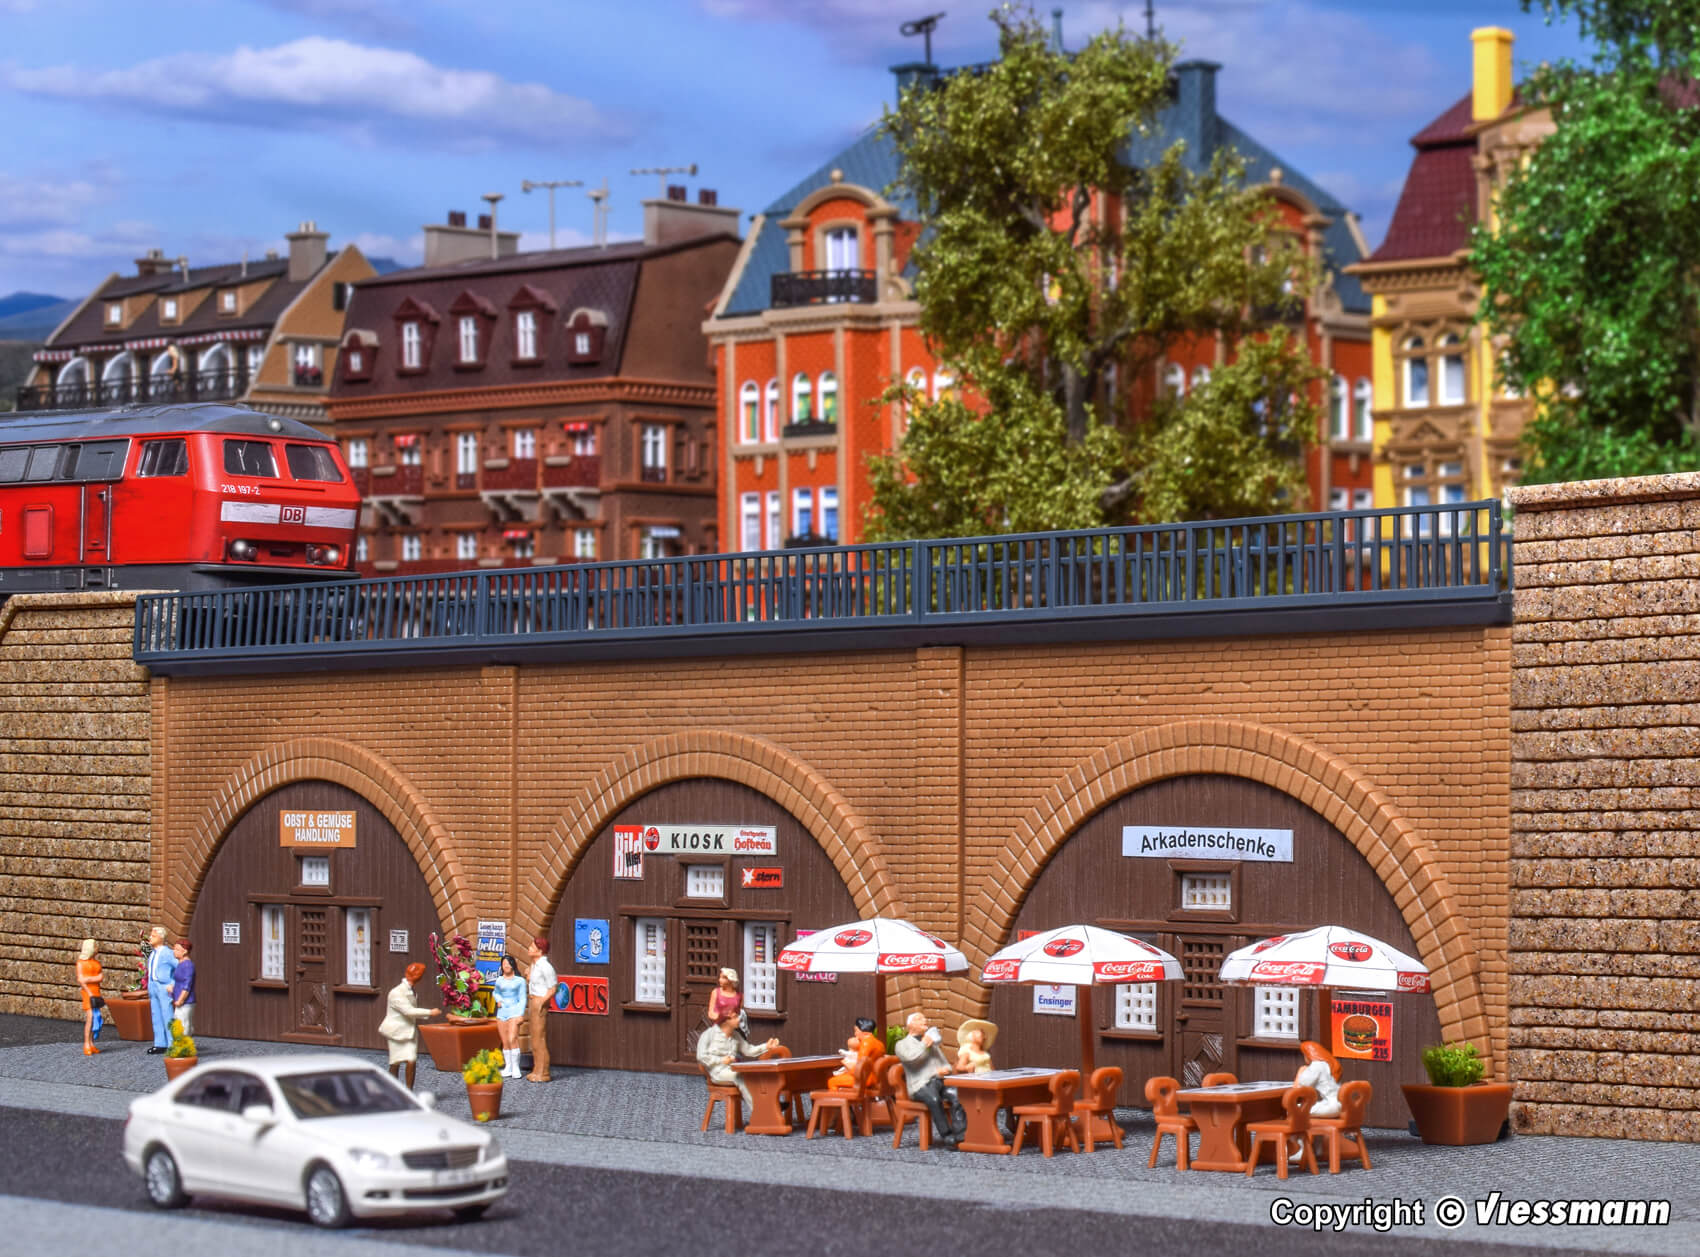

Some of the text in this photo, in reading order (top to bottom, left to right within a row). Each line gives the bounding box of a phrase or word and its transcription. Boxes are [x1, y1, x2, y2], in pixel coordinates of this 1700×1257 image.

[221, 484, 261, 495] 218 197-2
[283, 508, 302, 521] DB
[284, 812, 352, 828] OBST & GEMÜSE
[295, 828, 340, 842] HANDLUNG
[671, 833, 724, 850] KIOSK
[1141, 830, 1276, 858] Arkadenschenke
[614, 832, 643, 877] Bild
[755, 871, 780, 882] stern
[478, 938, 504, 952] bella
[884, 954, 938, 966] Coca-Cola
[1101, 961, 1154, 974] Coca-Cola
[550, 982, 608, 1011] OCUS
[1038, 994, 1073, 1008] Ensinger
